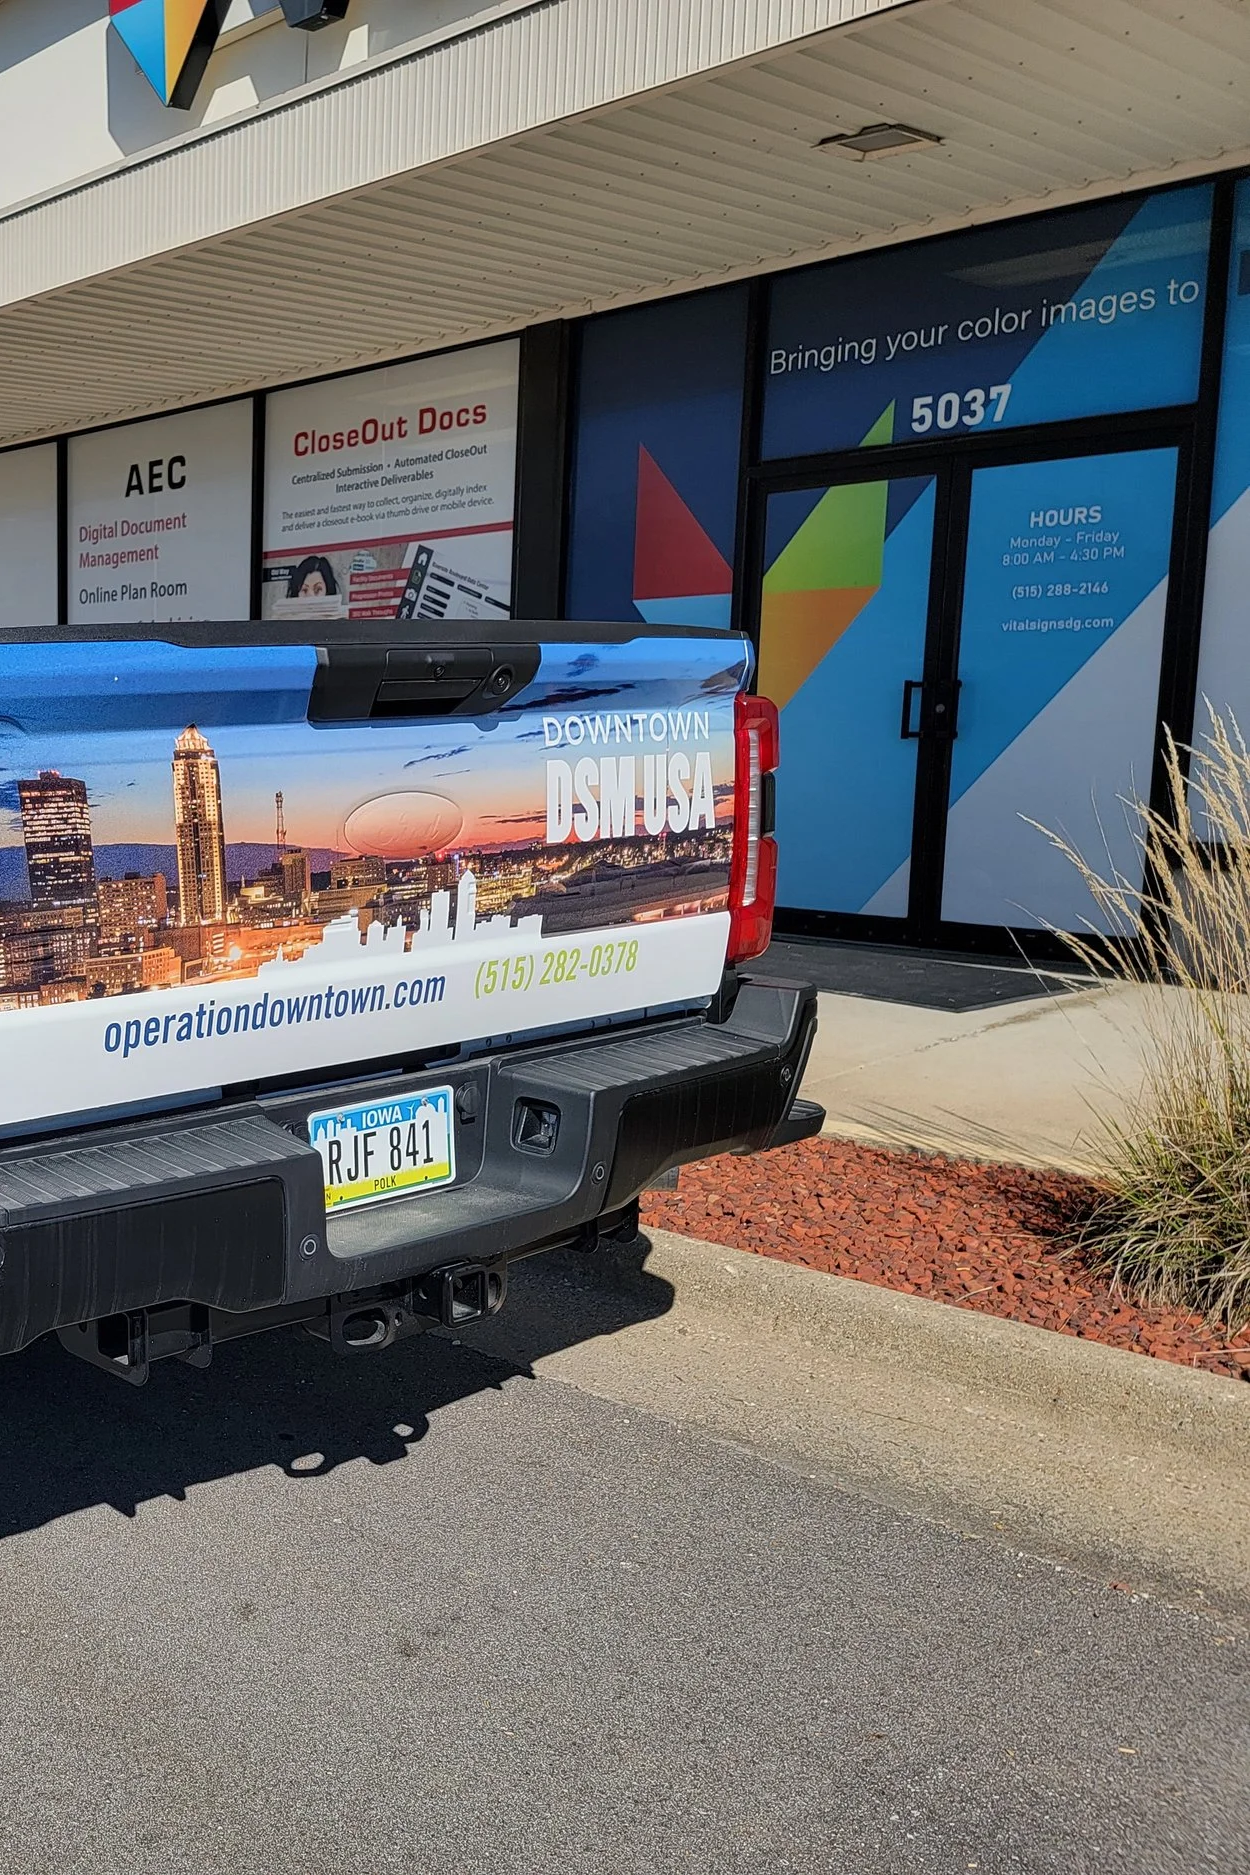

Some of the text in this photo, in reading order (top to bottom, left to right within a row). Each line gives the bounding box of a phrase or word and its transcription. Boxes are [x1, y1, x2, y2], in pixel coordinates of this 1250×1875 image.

[769, 278, 1200, 375] Bringing your color images to
[910, 383, 1012, 433] 5037
[293, 404, 487, 457] CloseOut Docs
[124, 454, 187, 498] AEC
[291, 444, 488, 485] Centralized Submission Automated CloseOut
[335, 469, 434, 494] Interactive Deliverables
[281, 511, 294, 520] The
[316, 504, 329, 515] and
[352, 501, 366, 512] way
[366, 500, 375, 509] to
[434, 485, 465, 500] digitally
[465, 483, 487, 494] index
[294, 520, 316, 531] deliver
[375, 511, 386, 520] via
[386, 507, 410, 518] thumb
[411, 504, 430, 516] drive
[430, 504, 439, 513] or
[439, 499, 466, 512] mobile
[1029, 505, 1102, 529] HOURS
[78, 512, 187, 545] Digital Document
[1010, 535, 1061, 549] Monday
[1076, 530, 1120, 545] Friday
[78, 544, 159, 569] Management
[1002, 552, 1029, 566] 8:00
[1033, 551, 1055, 564] AM
[1070, 547, 1099, 562] 4:30
[1103, 545, 1125, 560] PM
[78, 581, 188, 604] Online Plan Room
[1012, 581, 1109, 600] (515) 288-2146
[1001, 616, 1114, 634] vitalsignsdg.com
[542, 711, 710, 747] DOWNTOWN
[546, 750, 716, 845] DSM USA
[473, 938, 639, 999] (515) 282-0378
[103, 974, 447, 1059] operationdowntown.com
[361, 1104, 403, 1130] IOWA
[328, 1119, 434, 1186] RJF 841
[373, 1174, 397, 1191] POLK
